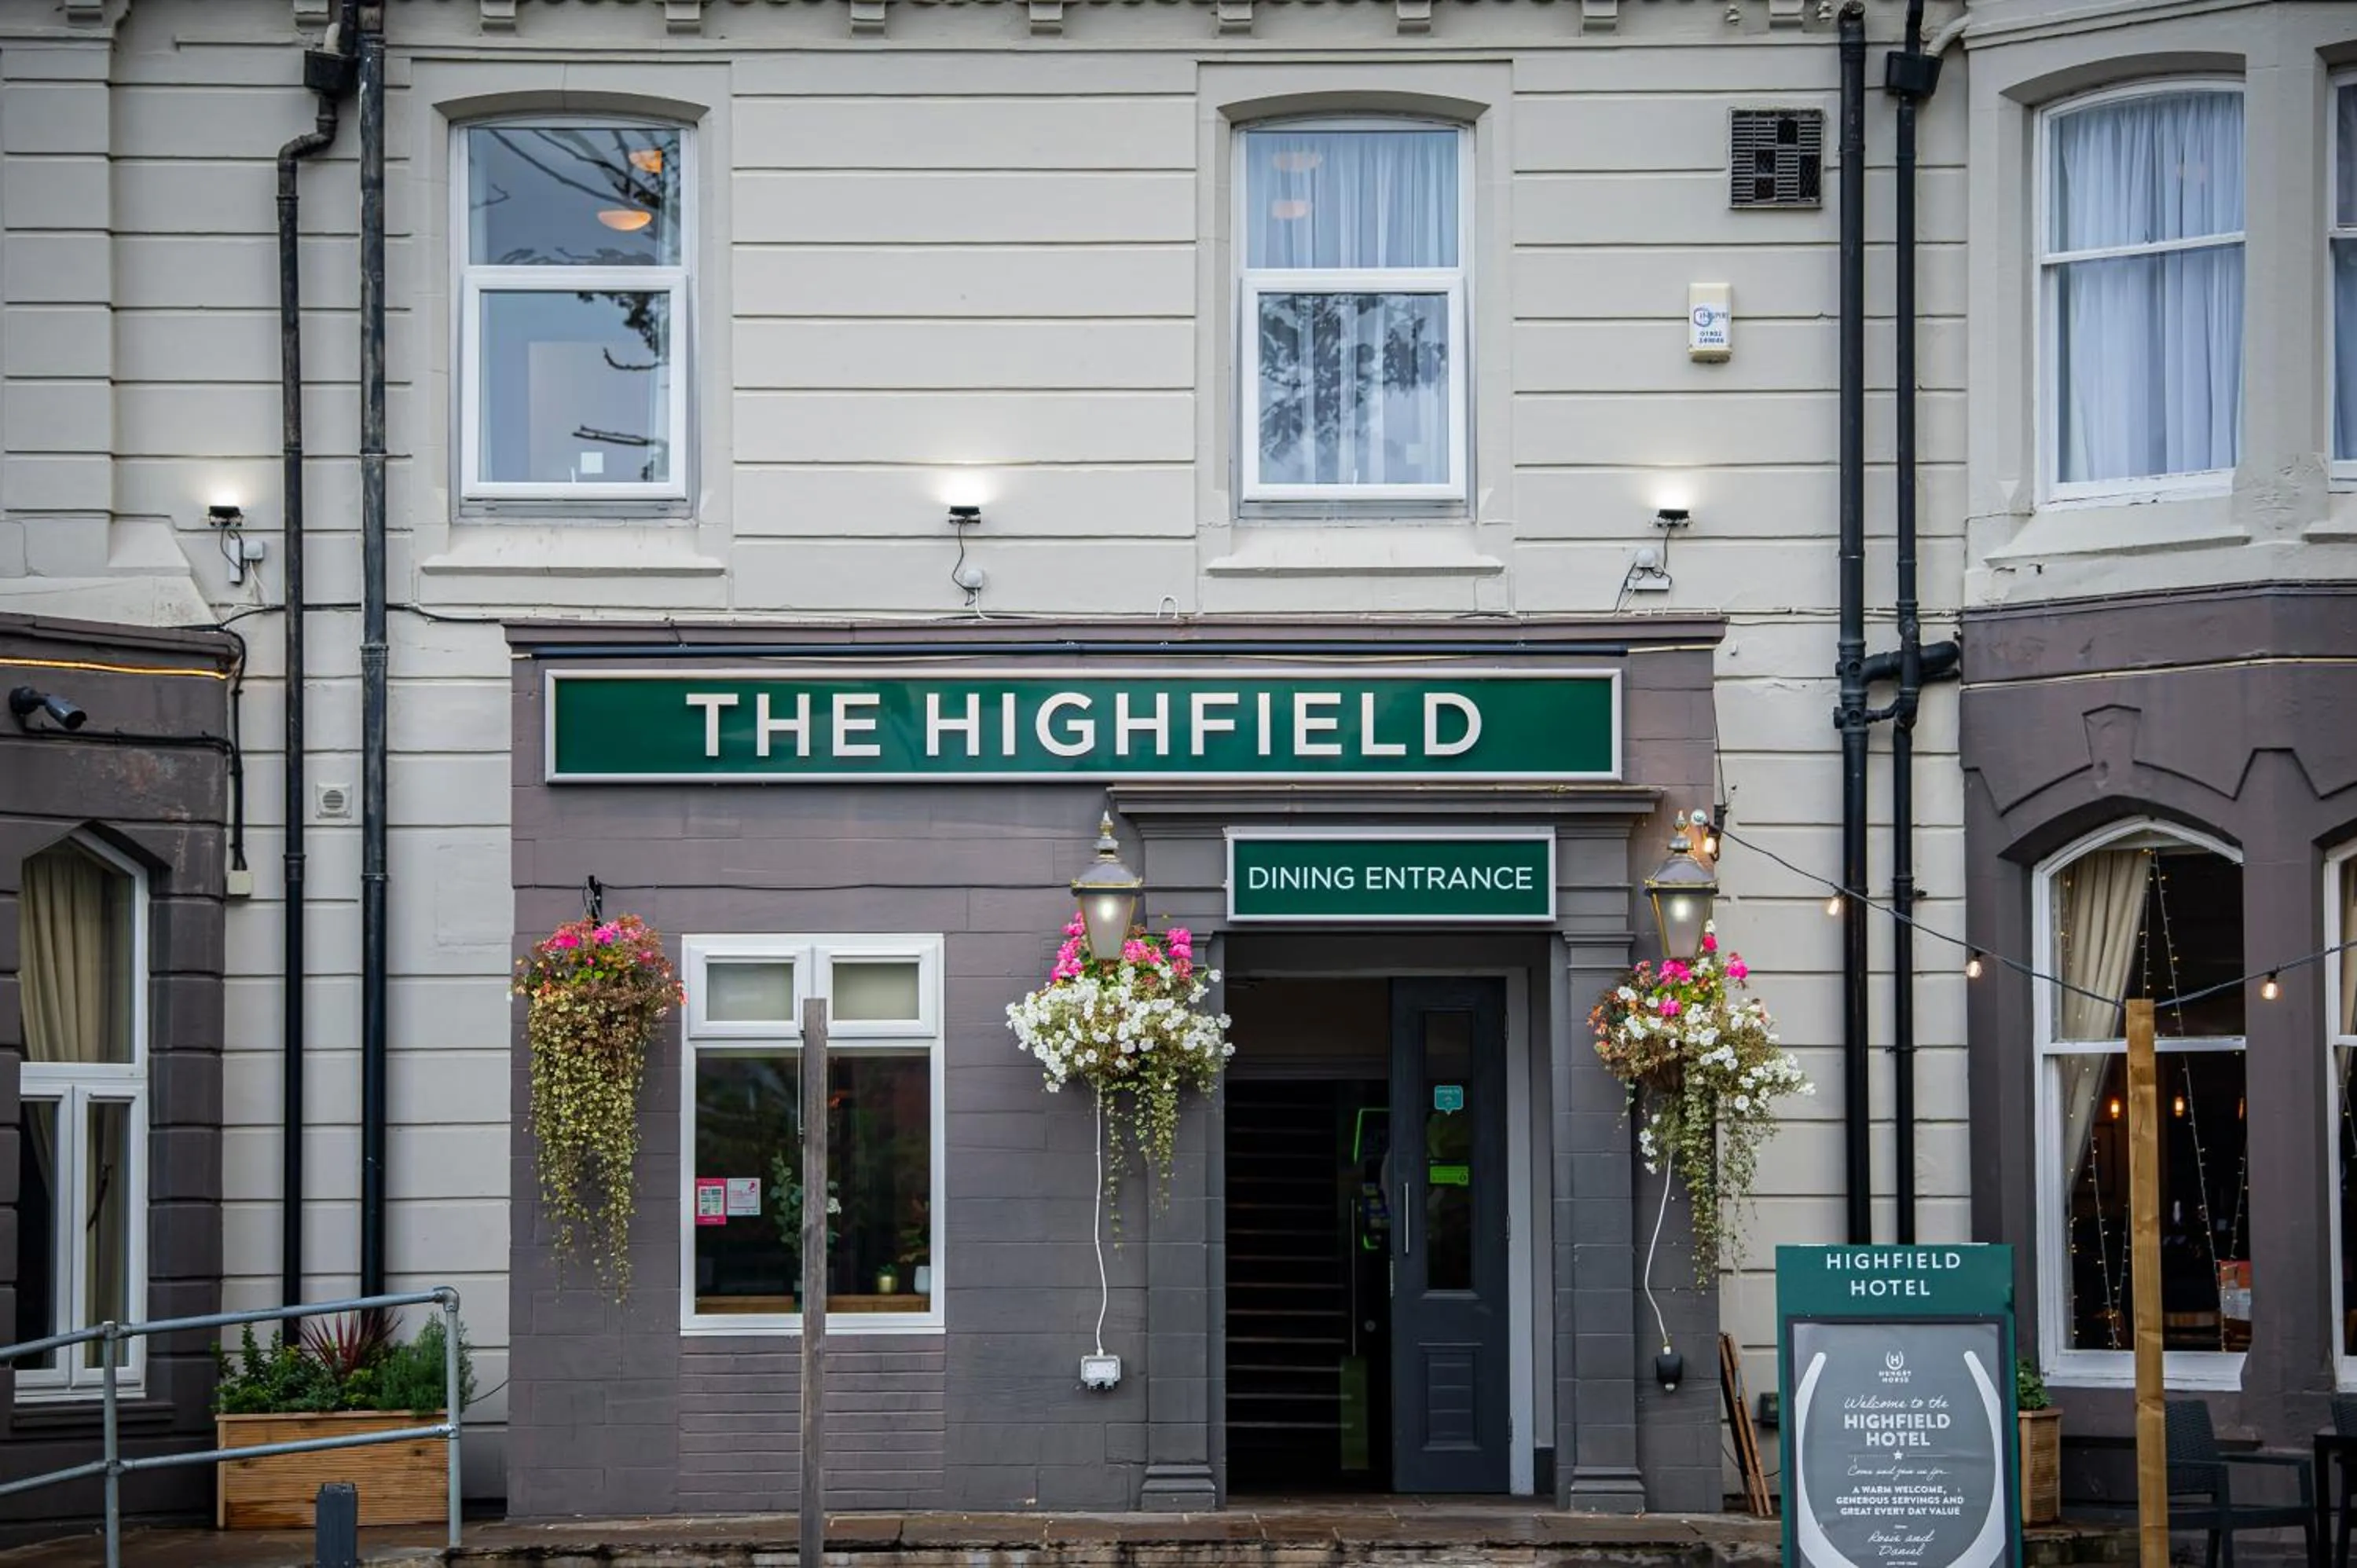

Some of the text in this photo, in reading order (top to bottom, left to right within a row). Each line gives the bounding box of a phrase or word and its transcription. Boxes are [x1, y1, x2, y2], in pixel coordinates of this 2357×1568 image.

[686, 691, 1483, 757] THE HIGHFIELD
[1248, 866, 1533, 890] DINING ENTRANCE
[1826, 1252, 1961, 1270] HIGHFIELD
[1850, 1279, 1930, 1296] HOTEL
[1890, 1354, 1899, 1365] H
[1844, 1394, 1949, 1409] Welcome to the
[1843, 1413, 1951, 1429] HIGHFIELD
[1866, 1431, 1930, 1446] HOTEL
[1852, 1486, 1947, 1496] A WARM WELCOME,
[1835, 1496, 1964, 1504] GENEROUS SERVINGS AND
[1840, 1507, 1960, 1515] GREAT EVERY DAY VALUE
[1904, 1529, 1935, 1542] and
